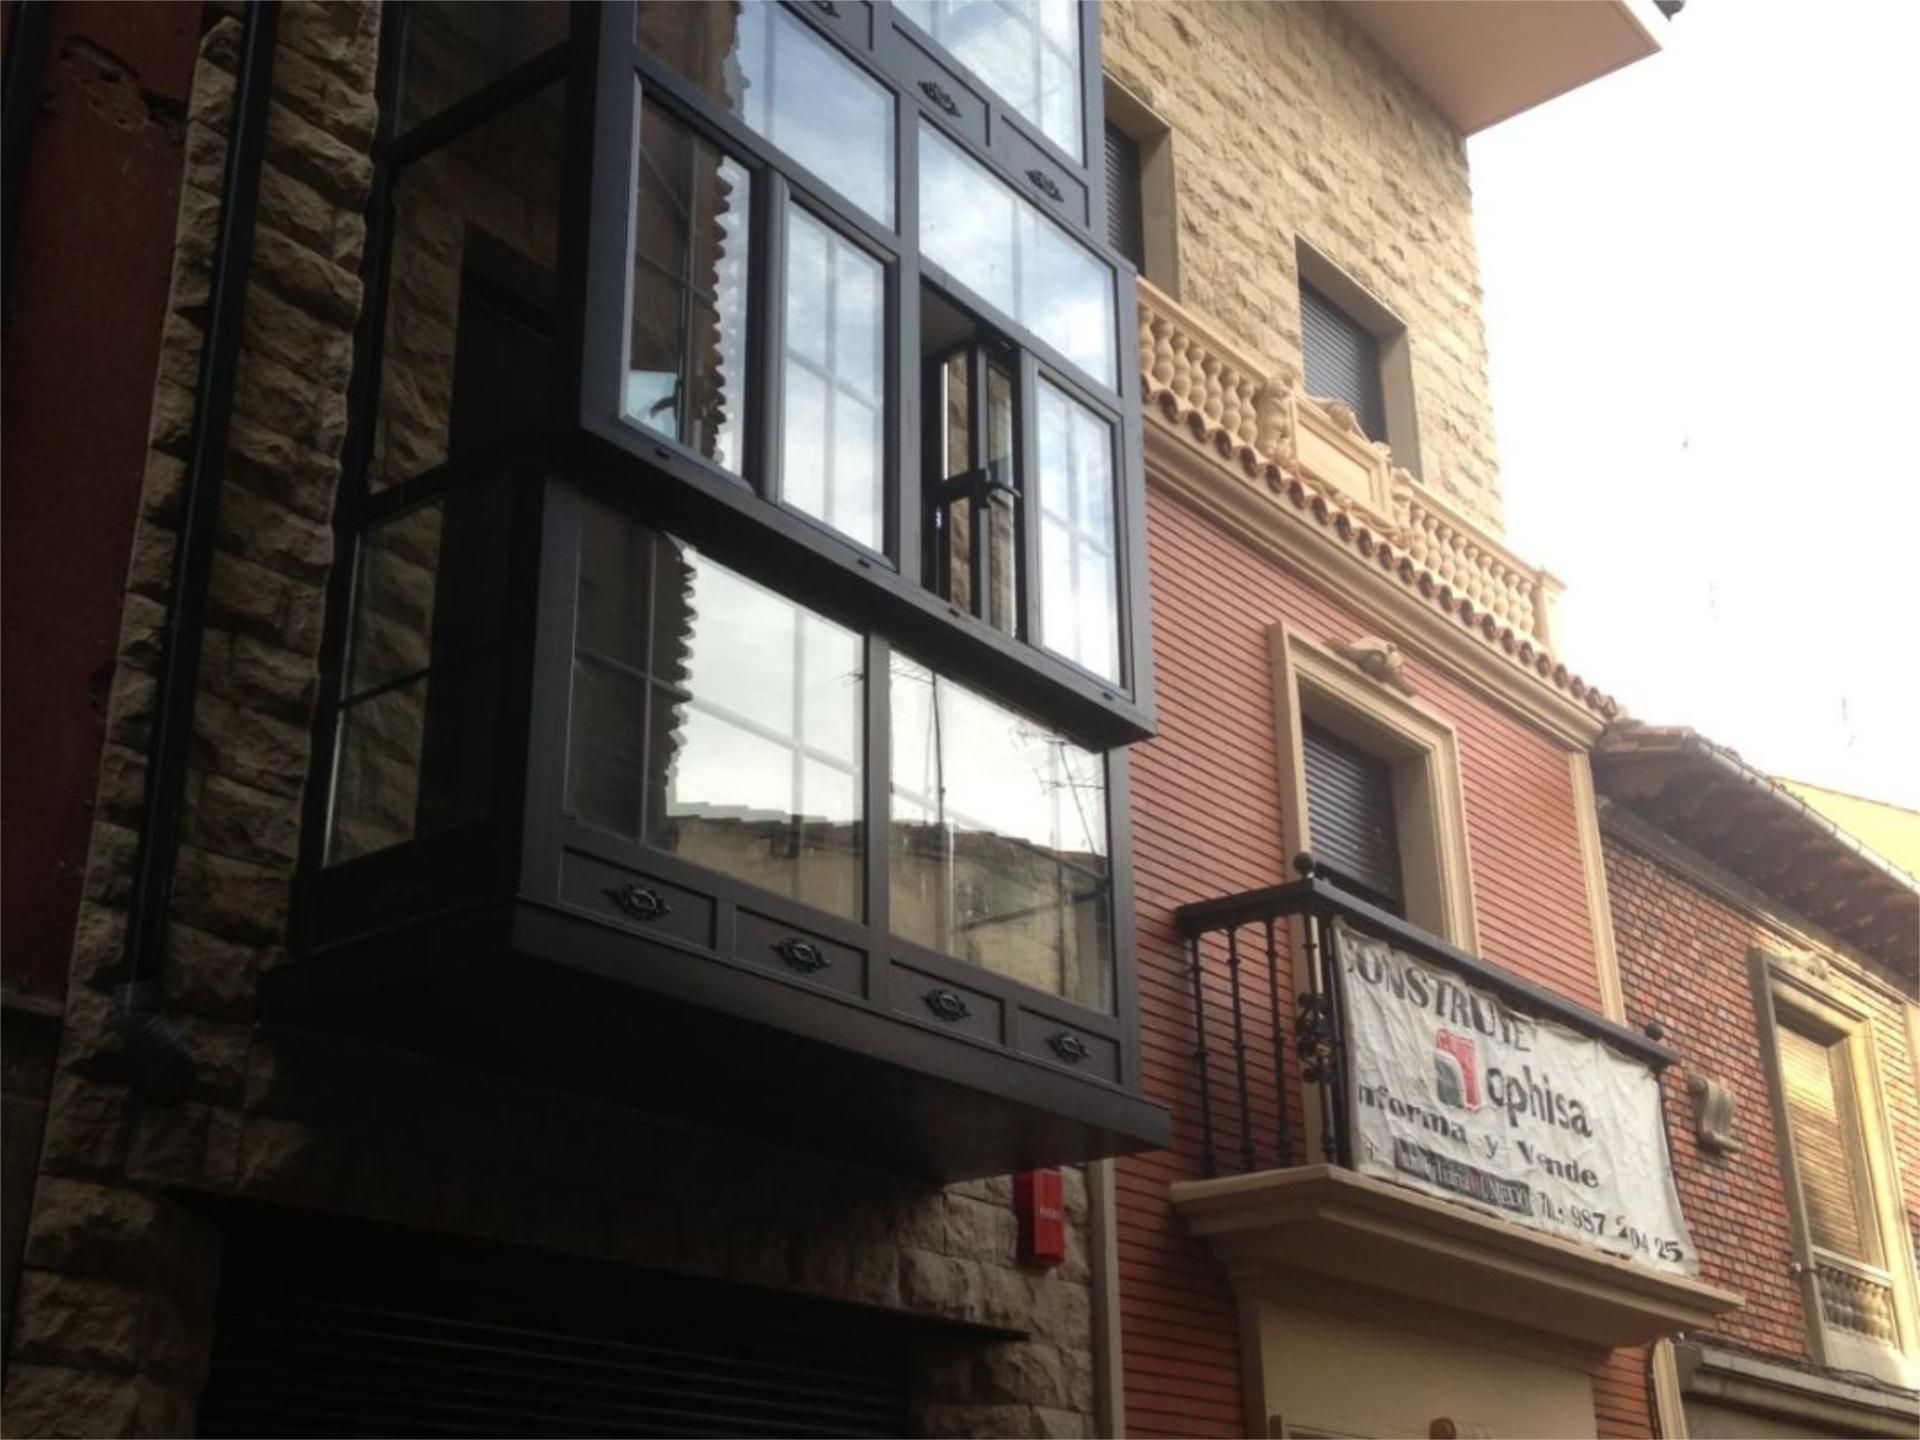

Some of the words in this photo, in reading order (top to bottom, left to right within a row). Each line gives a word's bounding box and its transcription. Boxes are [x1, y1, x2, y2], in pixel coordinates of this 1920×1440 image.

[1359, 1084, 1468, 1146] nforma
[1483, 1135, 1498, 1159] y
[1571, 1204, 1606, 1235] 987
[1654, 1236, 1684, 1263] 25
